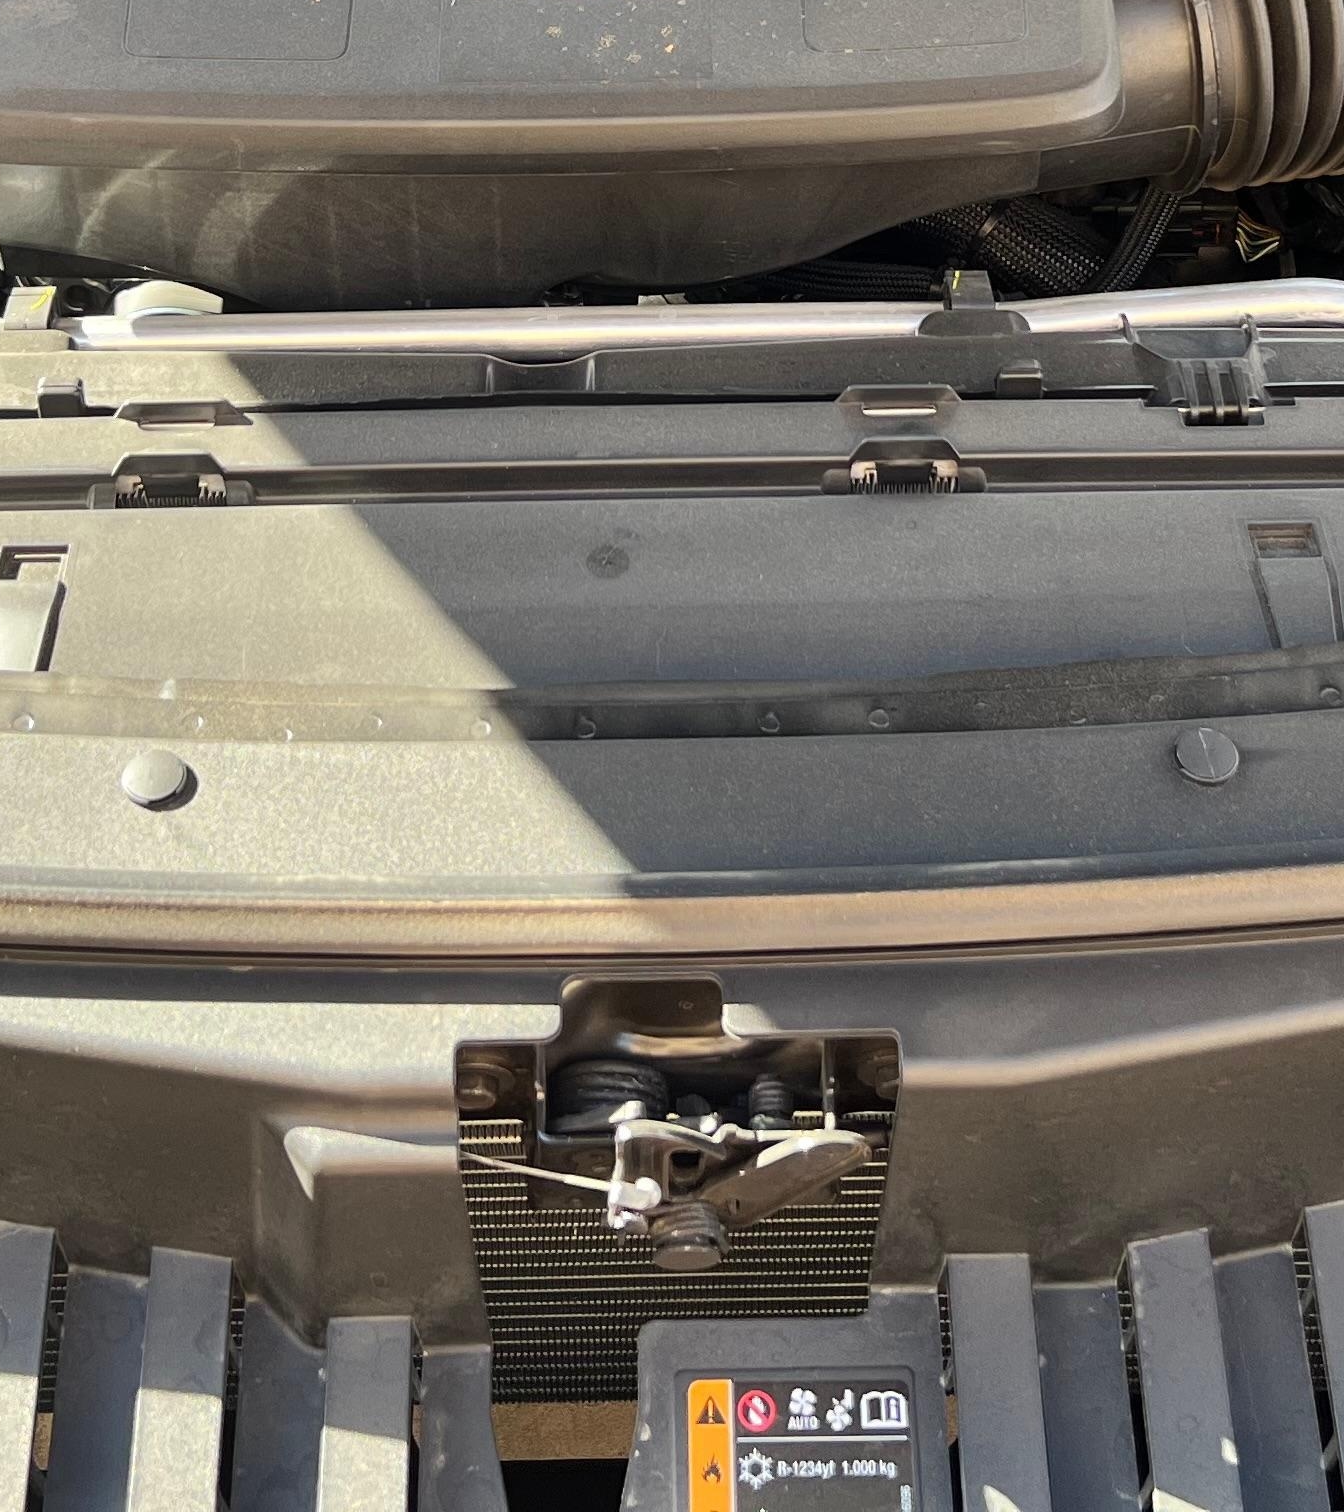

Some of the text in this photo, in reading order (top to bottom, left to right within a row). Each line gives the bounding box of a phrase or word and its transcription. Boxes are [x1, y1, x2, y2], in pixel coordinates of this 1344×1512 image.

[787, 1415, 820, 1431] AUTO
[841, 1459, 877, 1476] 1.000
[879, 1459, 898, 1480] kg
